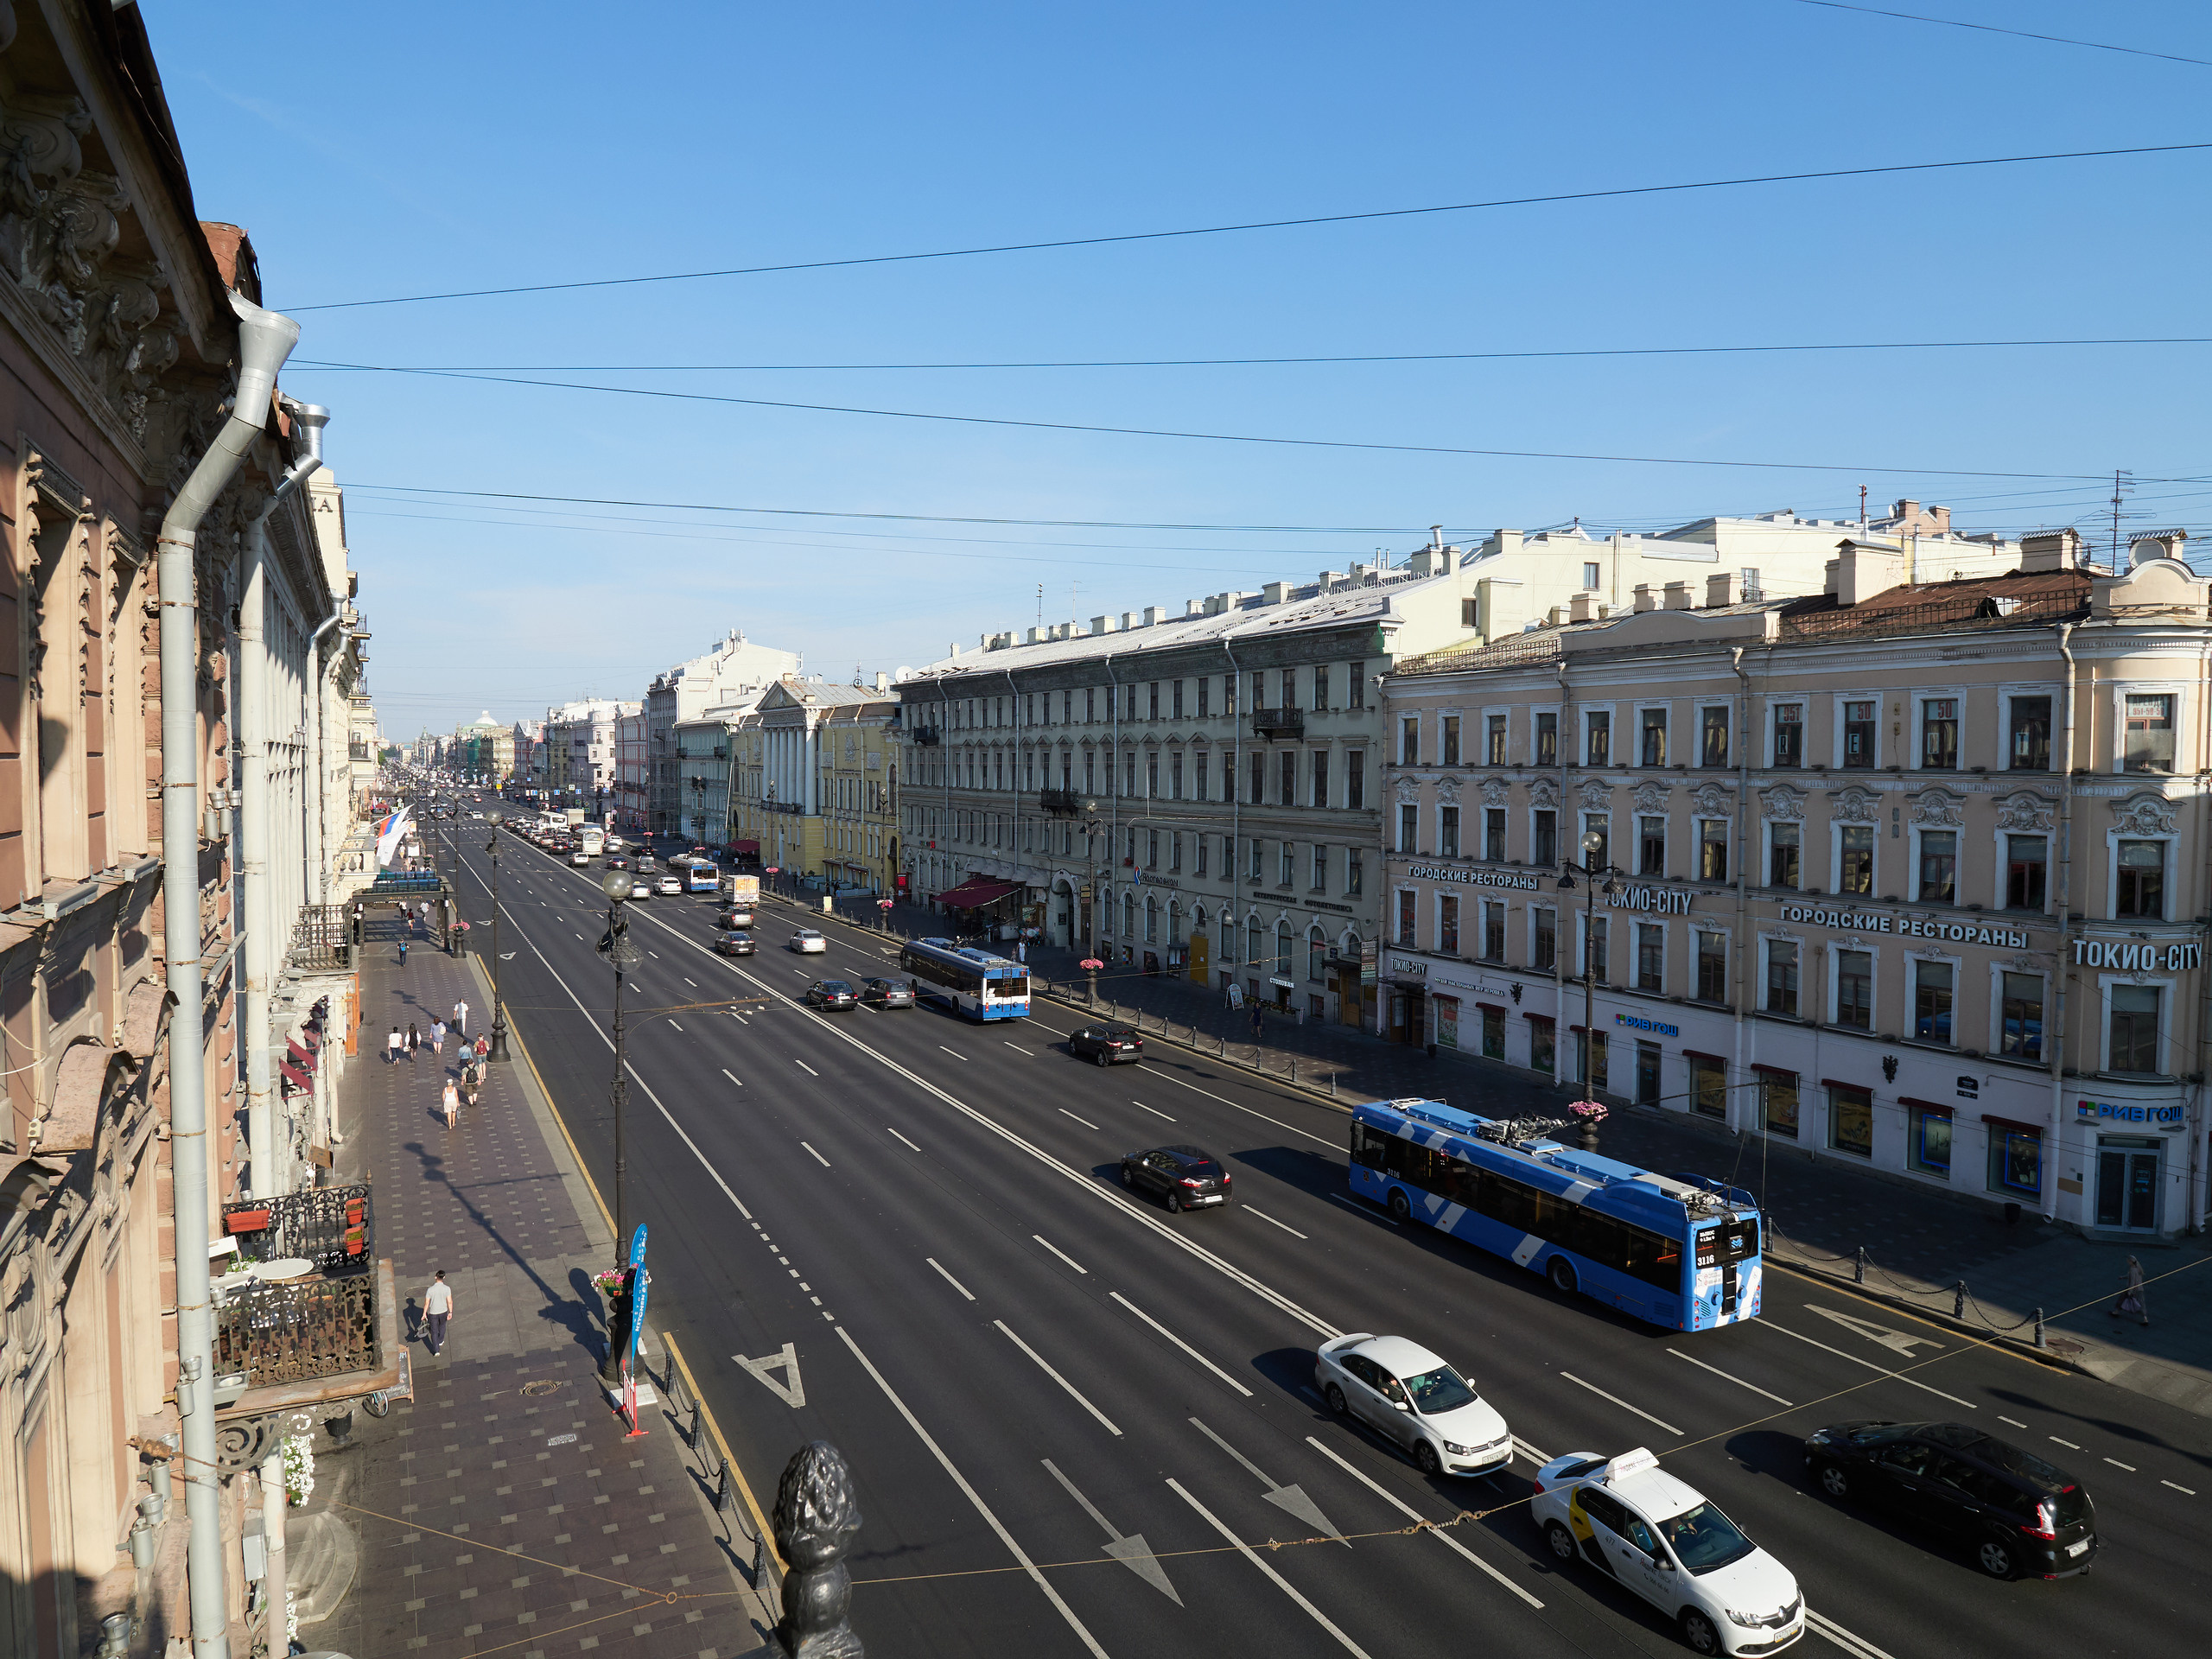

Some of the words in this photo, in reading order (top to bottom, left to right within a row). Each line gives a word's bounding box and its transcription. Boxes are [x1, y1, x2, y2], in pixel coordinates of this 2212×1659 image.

[1408, 866, 1467, 882] ГОРОДСКИЕ
[1471, 872, 1538, 890] РЕСТОРАНЫ
[1780, 906, 1891, 932] ГОРОДСКИЕ
[1898, 919, 2028, 949] РЕСТОРАНЫ
[2072, 939, 2203, 971] ТОКИО-CITY
[1626, 1016, 1651, 1031] РИВ
[1651, 1021, 1678, 1037] ГОШ
[2099, 1103, 2145, 1122] РИВ
[2146, 1106, 2183, 1122] ГОШ
[1387, 1167, 1401, 1179] 3116
[1697, 1254, 1715, 1267] 3116
[1605, 1535, 1616, 1547] 477
